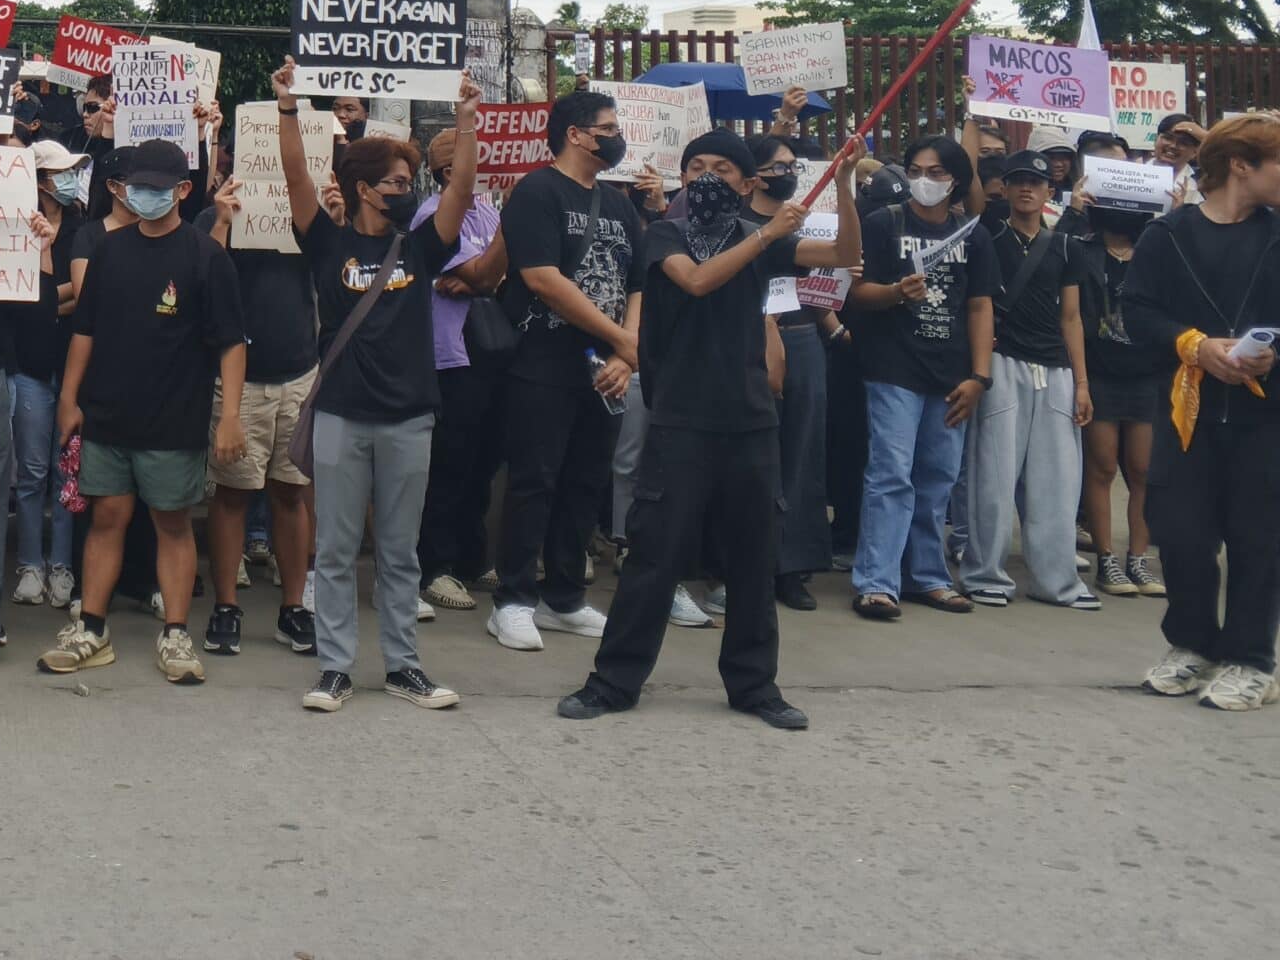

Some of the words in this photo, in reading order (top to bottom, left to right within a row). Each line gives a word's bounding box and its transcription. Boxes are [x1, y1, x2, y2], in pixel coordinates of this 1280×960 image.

[397, 0, 456, 25] AGAIN
[61, 21, 104, 46] JOIN
[298, 32, 371, 57] NEVER
[372, 29, 463, 64] FORGET
[746, 34, 800, 51] SABIHIN
[115, 51, 167, 60] THE
[807, 57, 832, 68] ANG
[989, 43, 1072, 76] MARCOS
[113, 60, 169, 77] CORRUPT
[1111, 66, 1147, 87] NO
[116, 77, 167, 91] HAS
[752, 77, 784, 90] PERA
[1048, 80, 1078, 92] JAIL
[113, 89, 197, 106] MORALS
[1049, 91, 1081, 109] TIME
[1117, 111, 1136, 126] HERE
[130, 123, 185, 138] ACCOUNTABILITY
[240, 153, 278, 173] SANA
[242, 182, 259, 196] NA
[274, 202, 289, 213] NG
[796, 227, 832, 238] ARCOS
